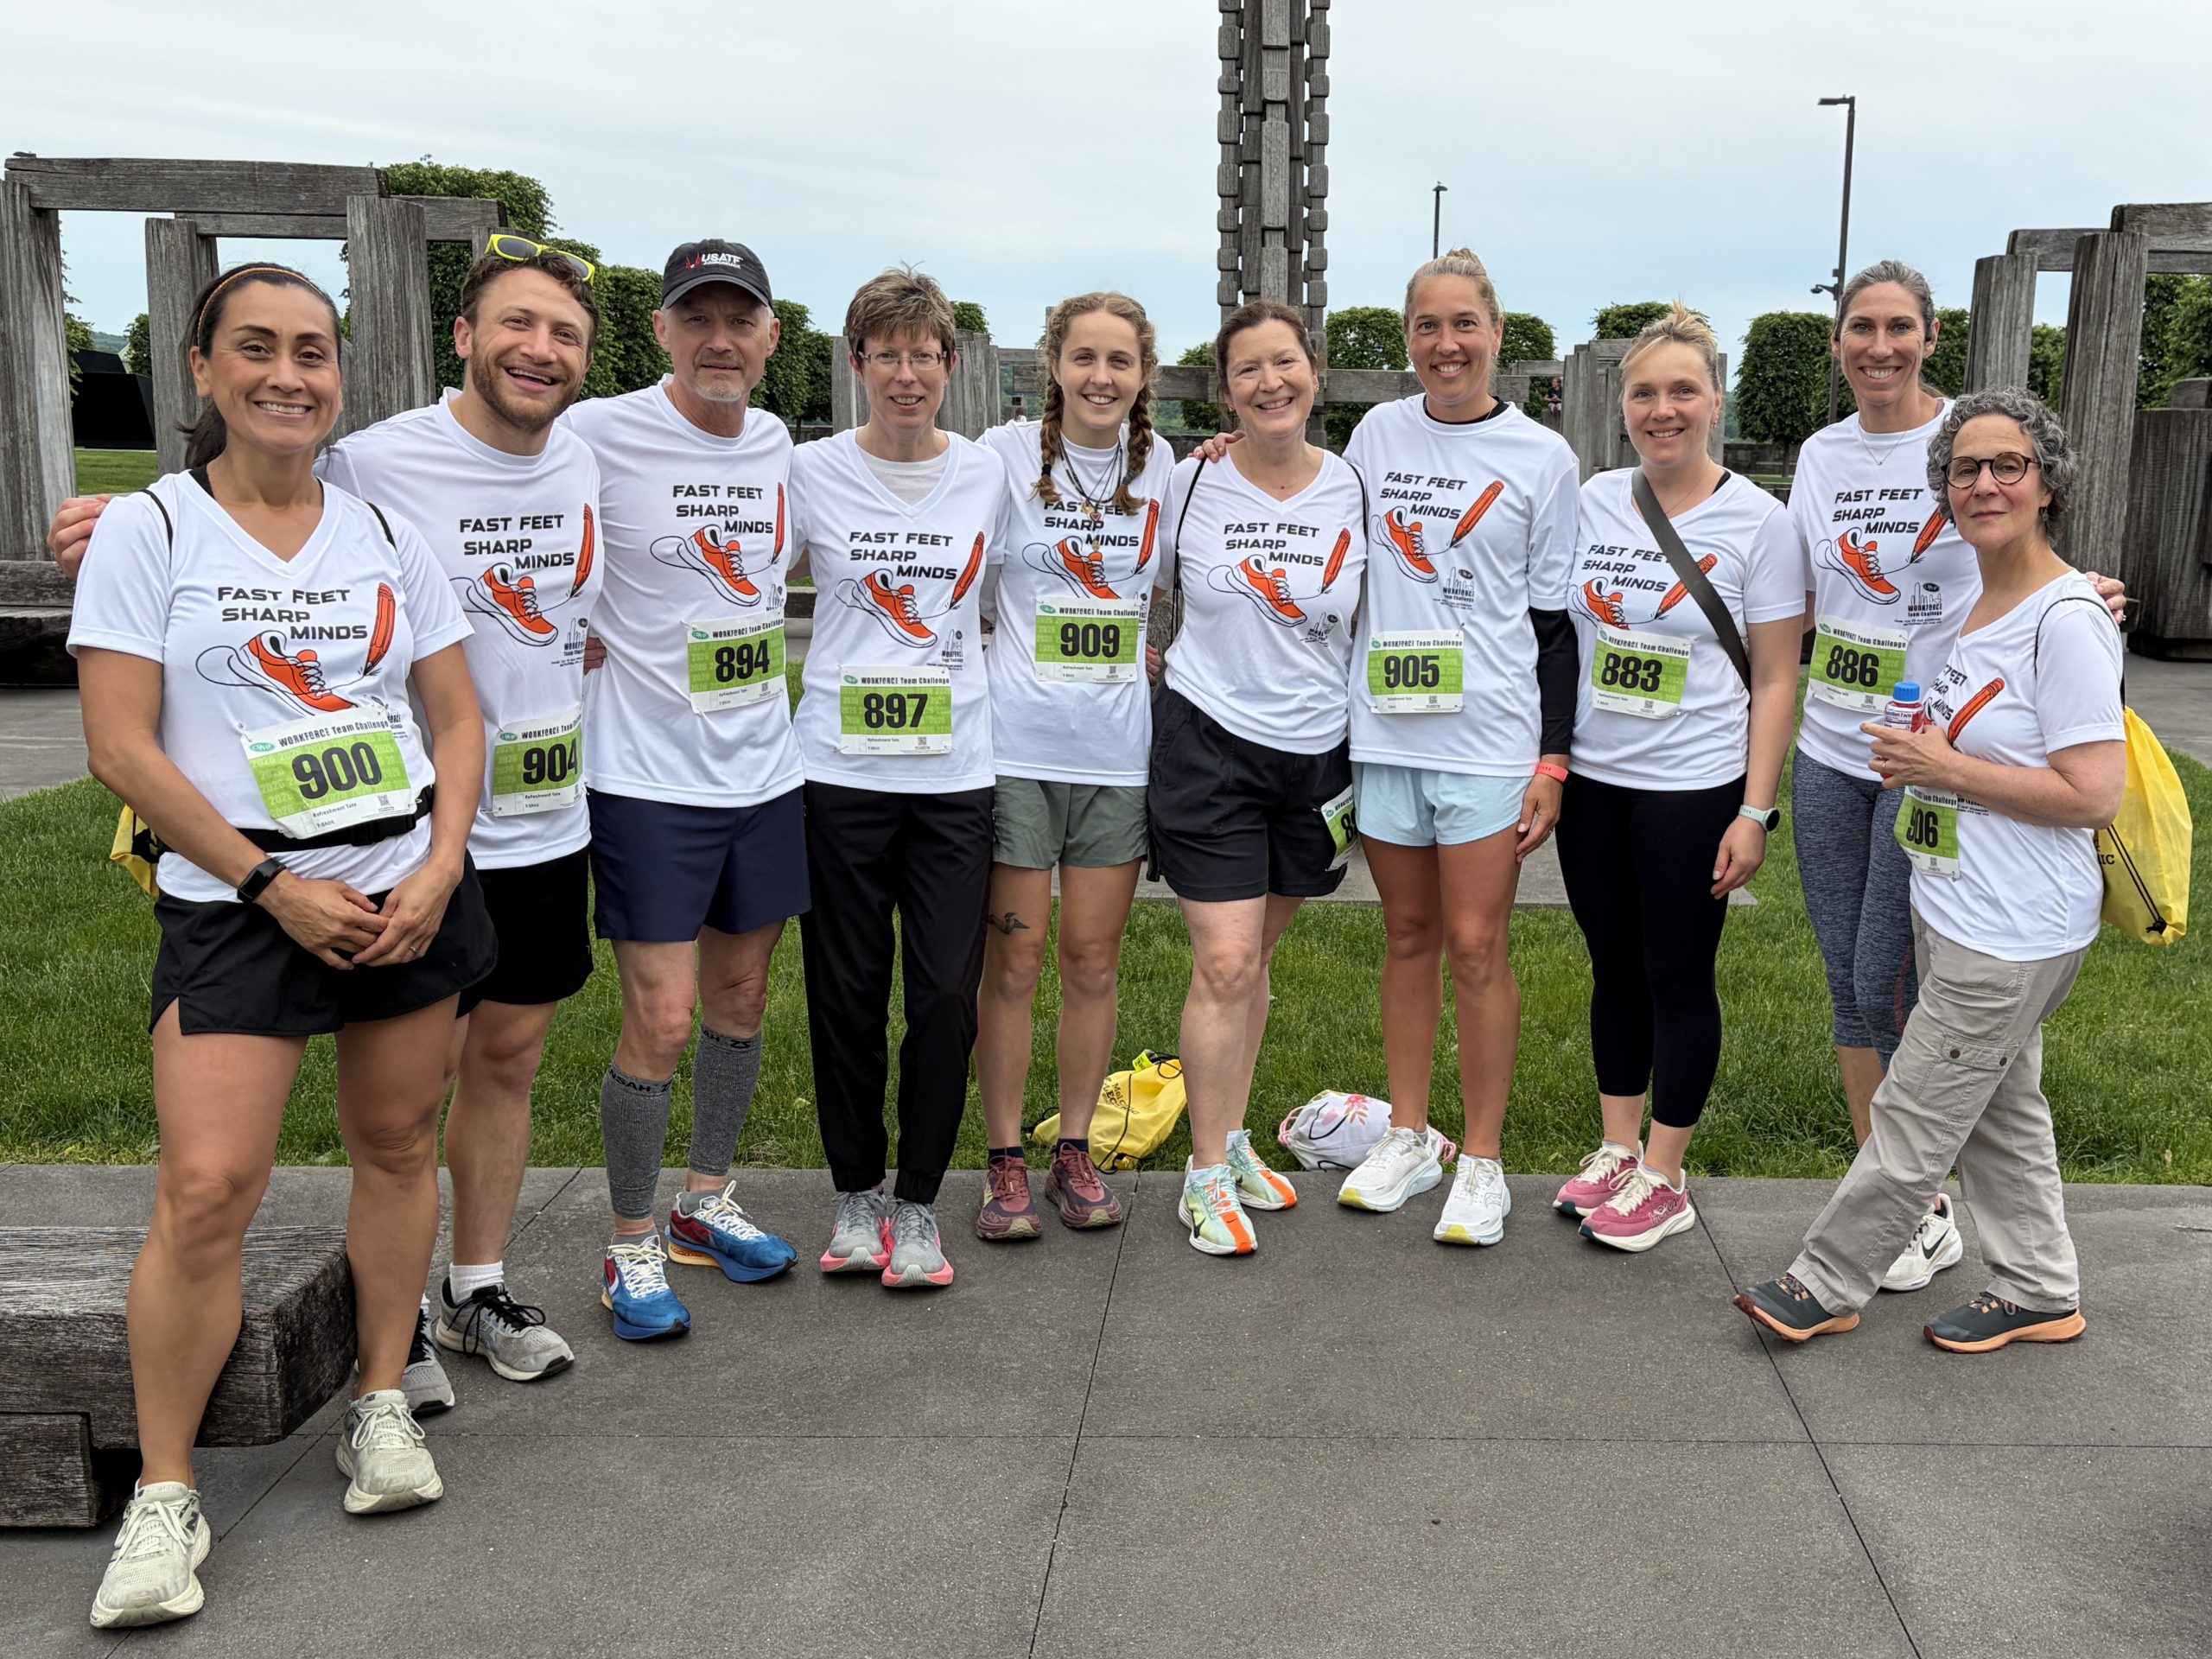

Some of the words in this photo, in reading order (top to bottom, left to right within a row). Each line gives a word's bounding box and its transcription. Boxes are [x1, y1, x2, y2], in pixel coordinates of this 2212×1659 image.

[702, 252, 743, 264] USATF
[1384, 472, 1425, 486] FAST
[1427, 476, 1468, 492] FEET
[672, 485, 721, 498] FAST
[727, 486, 763, 499] FEET
[1380, 488, 1433, 502] SHARP
[1834, 489, 1874, 504] FAST
[1878, 488, 1924, 501] FEET
[676, 505, 740, 518] SHARP
[1044, 501, 1083, 513] FAS
[1096, 504, 1130, 517] FEE
[1409, 504, 1462, 520] MINDS
[1832, 507, 1885, 522] SHARP
[460, 518, 512, 534] FAST
[519, 514, 564, 531] FEET
[724, 520, 774, 534] MINDS
[1044, 517, 1104, 531] SHARP
[1224, 523, 1269, 535] FAST
[1276, 523, 1319, 537] FEET
[1865, 521, 1920, 534] MINDS
[464, 538, 532, 556] SHARP
[849, 531, 899, 543] FAST
[906, 532, 953, 547] FEET
[1085, 534, 1139, 547] MINDS
[1225, 538, 1287, 550] SHARP
[515, 551, 575, 570] MINDS
[850, 549, 917, 562] SHARP
[1268, 551, 1324, 567] MINDS
[1587, 544, 1629, 556] FAST
[1631, 549, 1669, 563] FEE
[896, 565, 958, 580] MINDS
[1582, 560, 1637, 574] SHARP
[1611, 575, 1669, 592] MINDS
[218, 587, 283, 601] FAST
[292, 588, 351, 604] FEET
[1443, 588, 1474, 597] WORKFORCE
[222, 607, 310, 622] SHARP
[1059, 607, 1095, 615] WORKFORCE
[1908, 603, 1942, 612] WORKFORCE
[290, 625, 368, 639] MINDS
[712, 628, 747, 639] WORKFORCE
[749, 625, 761, 633] Team
[762, 619, 784, 630] Challenge
[1060, 623, 1120, 658] 909
[1833, 628, 1857, 641] WORKFORCE
[1858, 635, 1872, 645] Team
[1872, 638, 1906, 649] Challenge
[1640, 642, 1656, 652] Team
[1657, 645, 1689, 657] Challenge
[715, 639, 770, 683] 894
[1826, 645, 1879, 687] 886
[1384, 655, 1440, 689] 905
[1601, 652, 1662, 693] 883
[864, 693, 928, 728] 897
[278, 728, 330, 747] WORKFORCE
[331, 722, 355, 734] Team
[355, 720, 389, 731] Challenge
[521, 728, 559, 739] WORKFORCE
[523, 737, 578, 785] 904
[291, 742, 383, 799] 900
[1932, 795, 1957, 805] Challenge
[1906, 805, 1938, 849] 906
